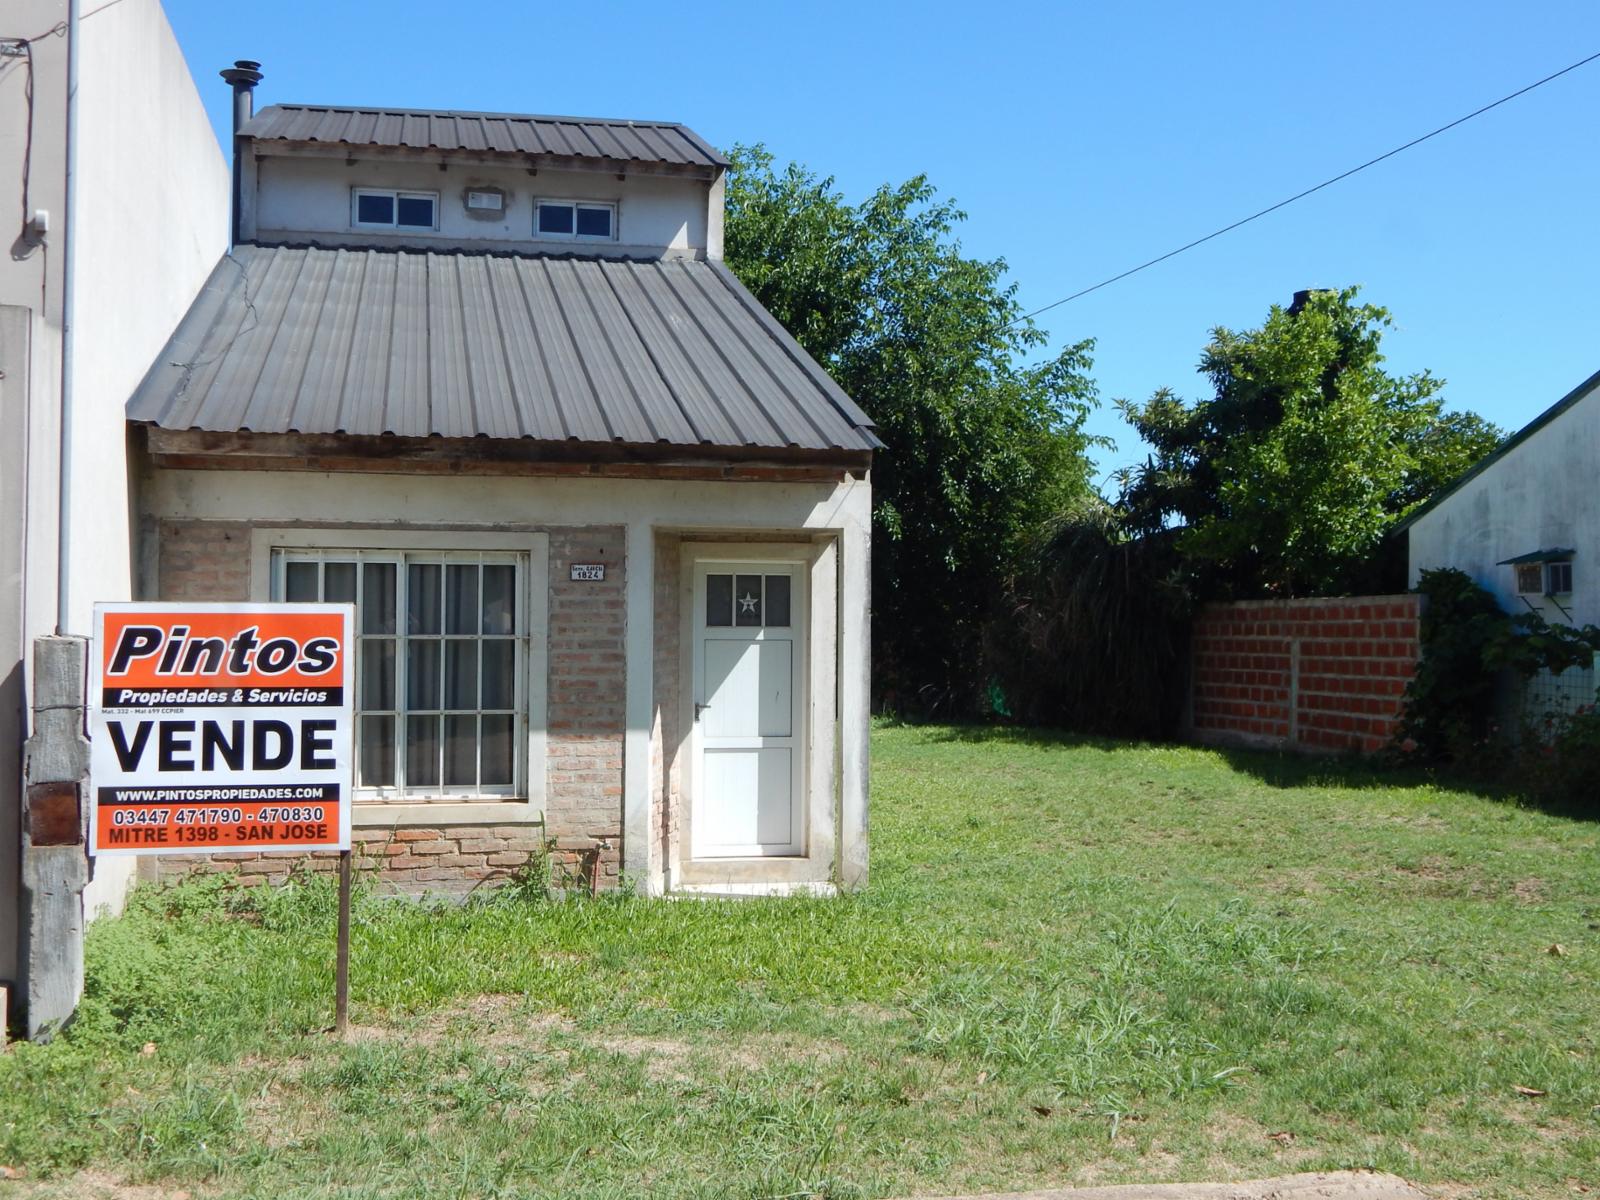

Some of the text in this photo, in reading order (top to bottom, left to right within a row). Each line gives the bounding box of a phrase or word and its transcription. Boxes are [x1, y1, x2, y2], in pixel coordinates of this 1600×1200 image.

[577, 571, 599, 579] 1824
[107, 625, 340, 676] Pintos
[118, 688, 327, 705] Propiedades & Servicios
[106, 719, 337, 772] VENDE
[115, 787, 323, 801] WWW.PINTOSPROPIEDADES.COM
[114, 808, 170, 825] 03447
[175, 807, 242, 824] 471790
[257, 806, 324, 823] 470830
[109, 827, 168, 844] MITRE
[175, 826, 219, 842] 1398
[236, 825, 274, 841] SAN
[280, 823, 328, 839] JOSE
